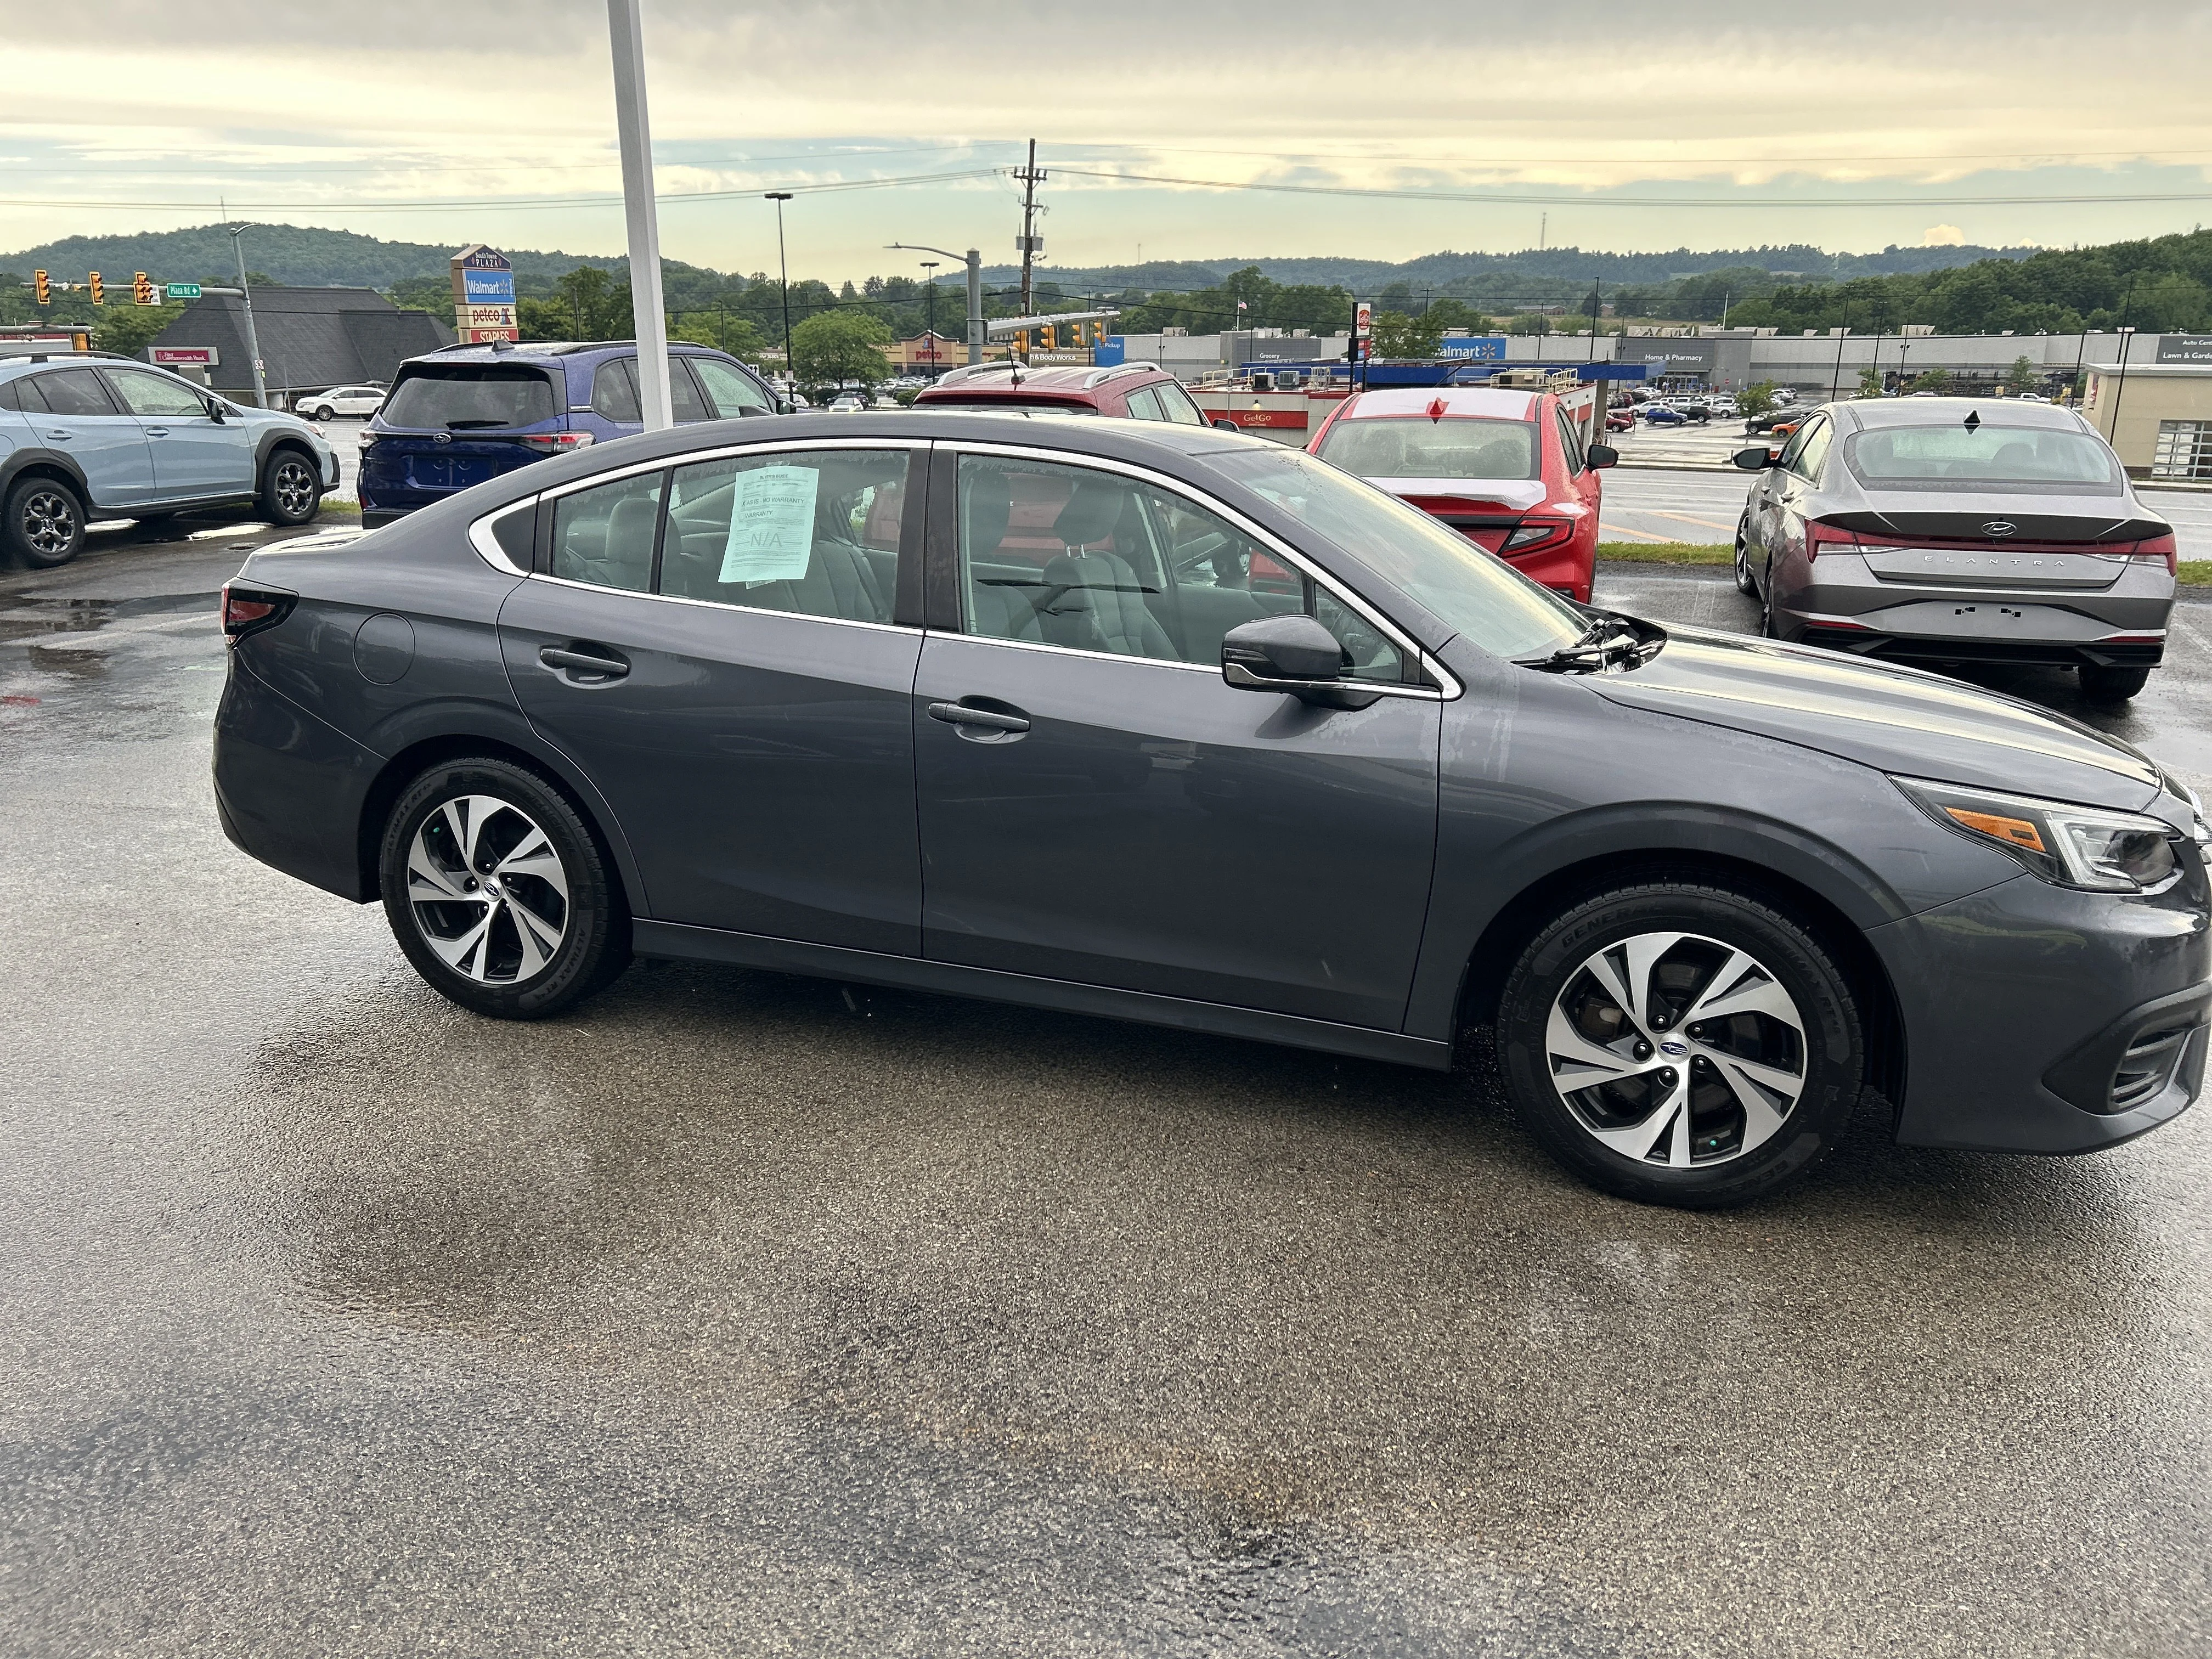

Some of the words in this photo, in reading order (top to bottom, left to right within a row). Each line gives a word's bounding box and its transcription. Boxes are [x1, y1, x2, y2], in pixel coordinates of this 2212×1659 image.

[476, 258, 498, 268] PLAZA
[170, 286, 183, 295] Plaza
[184, 286, 190, 295] Rd
[467, 279, 500, 295] Walmart
[472, 307, 500, 325] petco
[1431, 345, 1480, 357] almart
[1672, 354, 1702, 362] Pharmacy
[1243, 414, 1272, 422] GetGo
[745, 510, 773, 518] WARRANTY
[750, 531, 782, 548] N/A
[1924, 555, 2064, 567] ELANTRA
